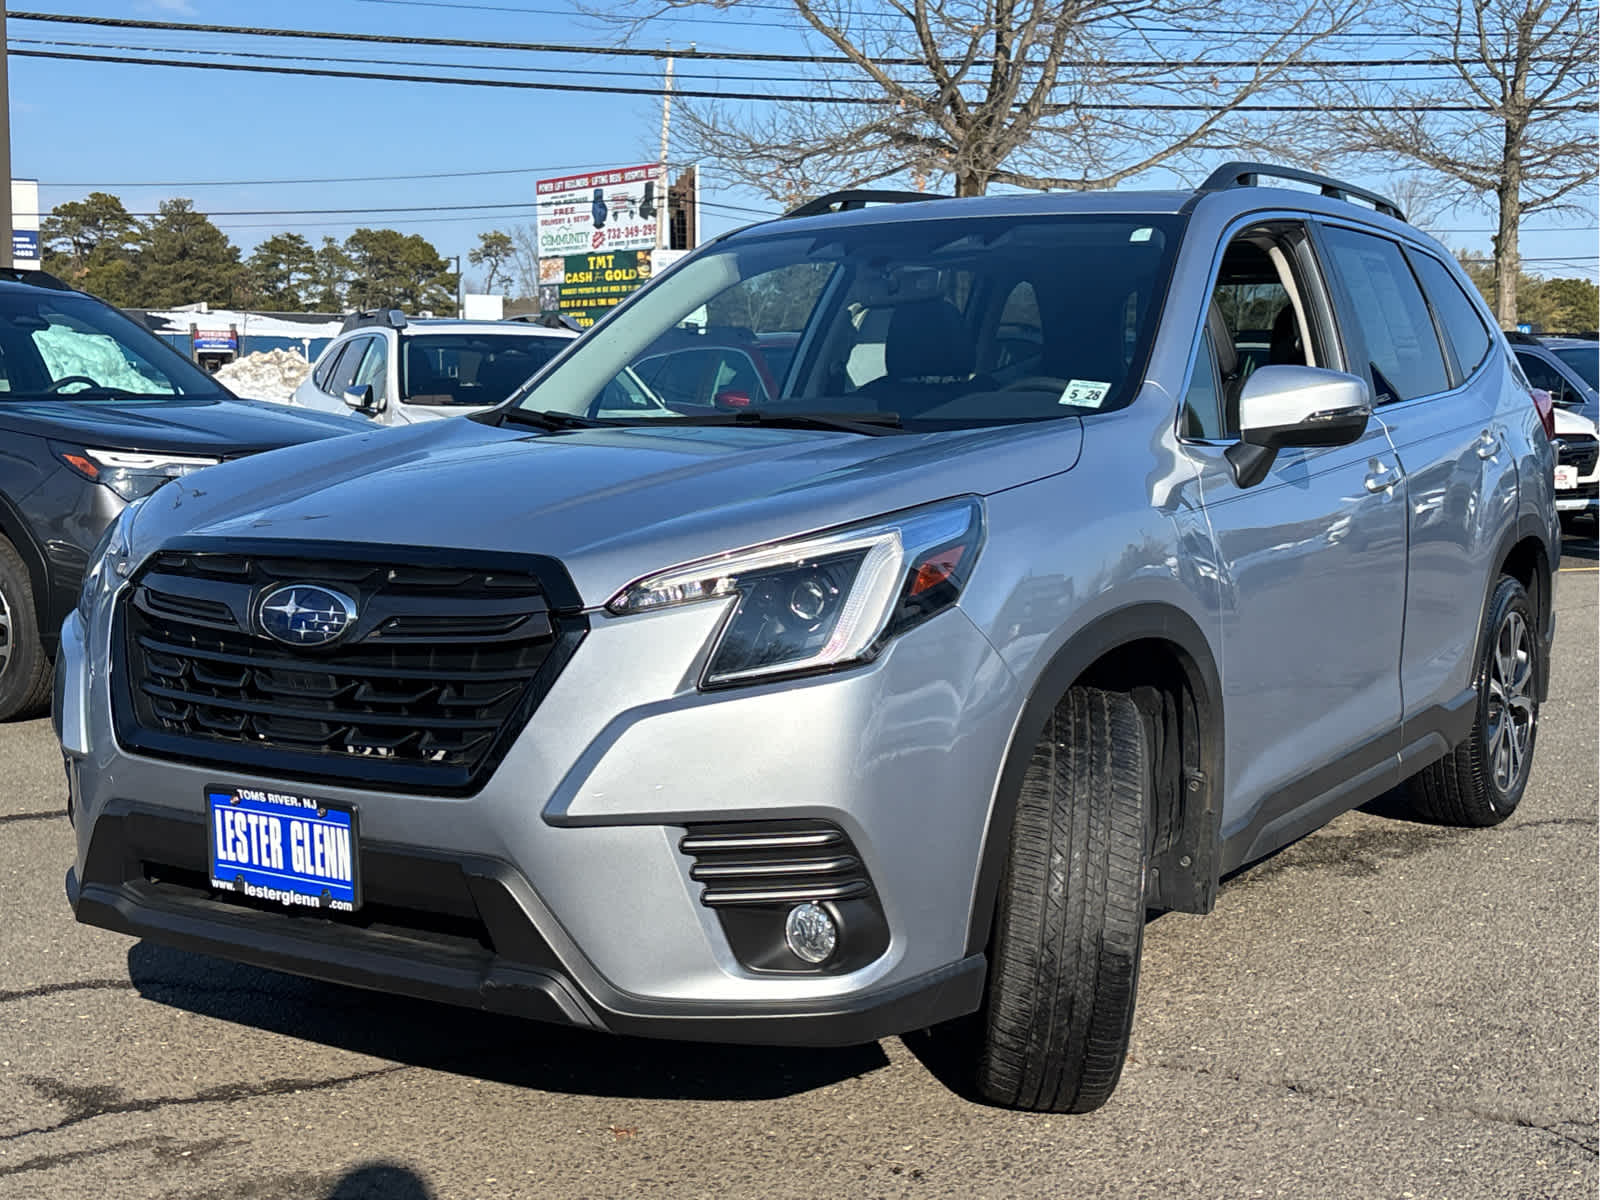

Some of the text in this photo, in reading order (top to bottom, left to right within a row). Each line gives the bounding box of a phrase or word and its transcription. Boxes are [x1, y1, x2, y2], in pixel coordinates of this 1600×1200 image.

[554, 206, 576, 216] FREE
[541, 231, 590, 246] COMMUNITY
[587, 254, 615, 270] TMT
[565, 271, 593, 284] CASH
[605, 268, 637, 281] GOLD
[1069, 389, 1102, 401] 5 28
[237, 789, 266, 802] TOMS
[303, 798, 318, 810] NJ
[214, 809, 352, 882] LESTER GLENN
[211, 879, 353, 911] www. lesterglenn .com
